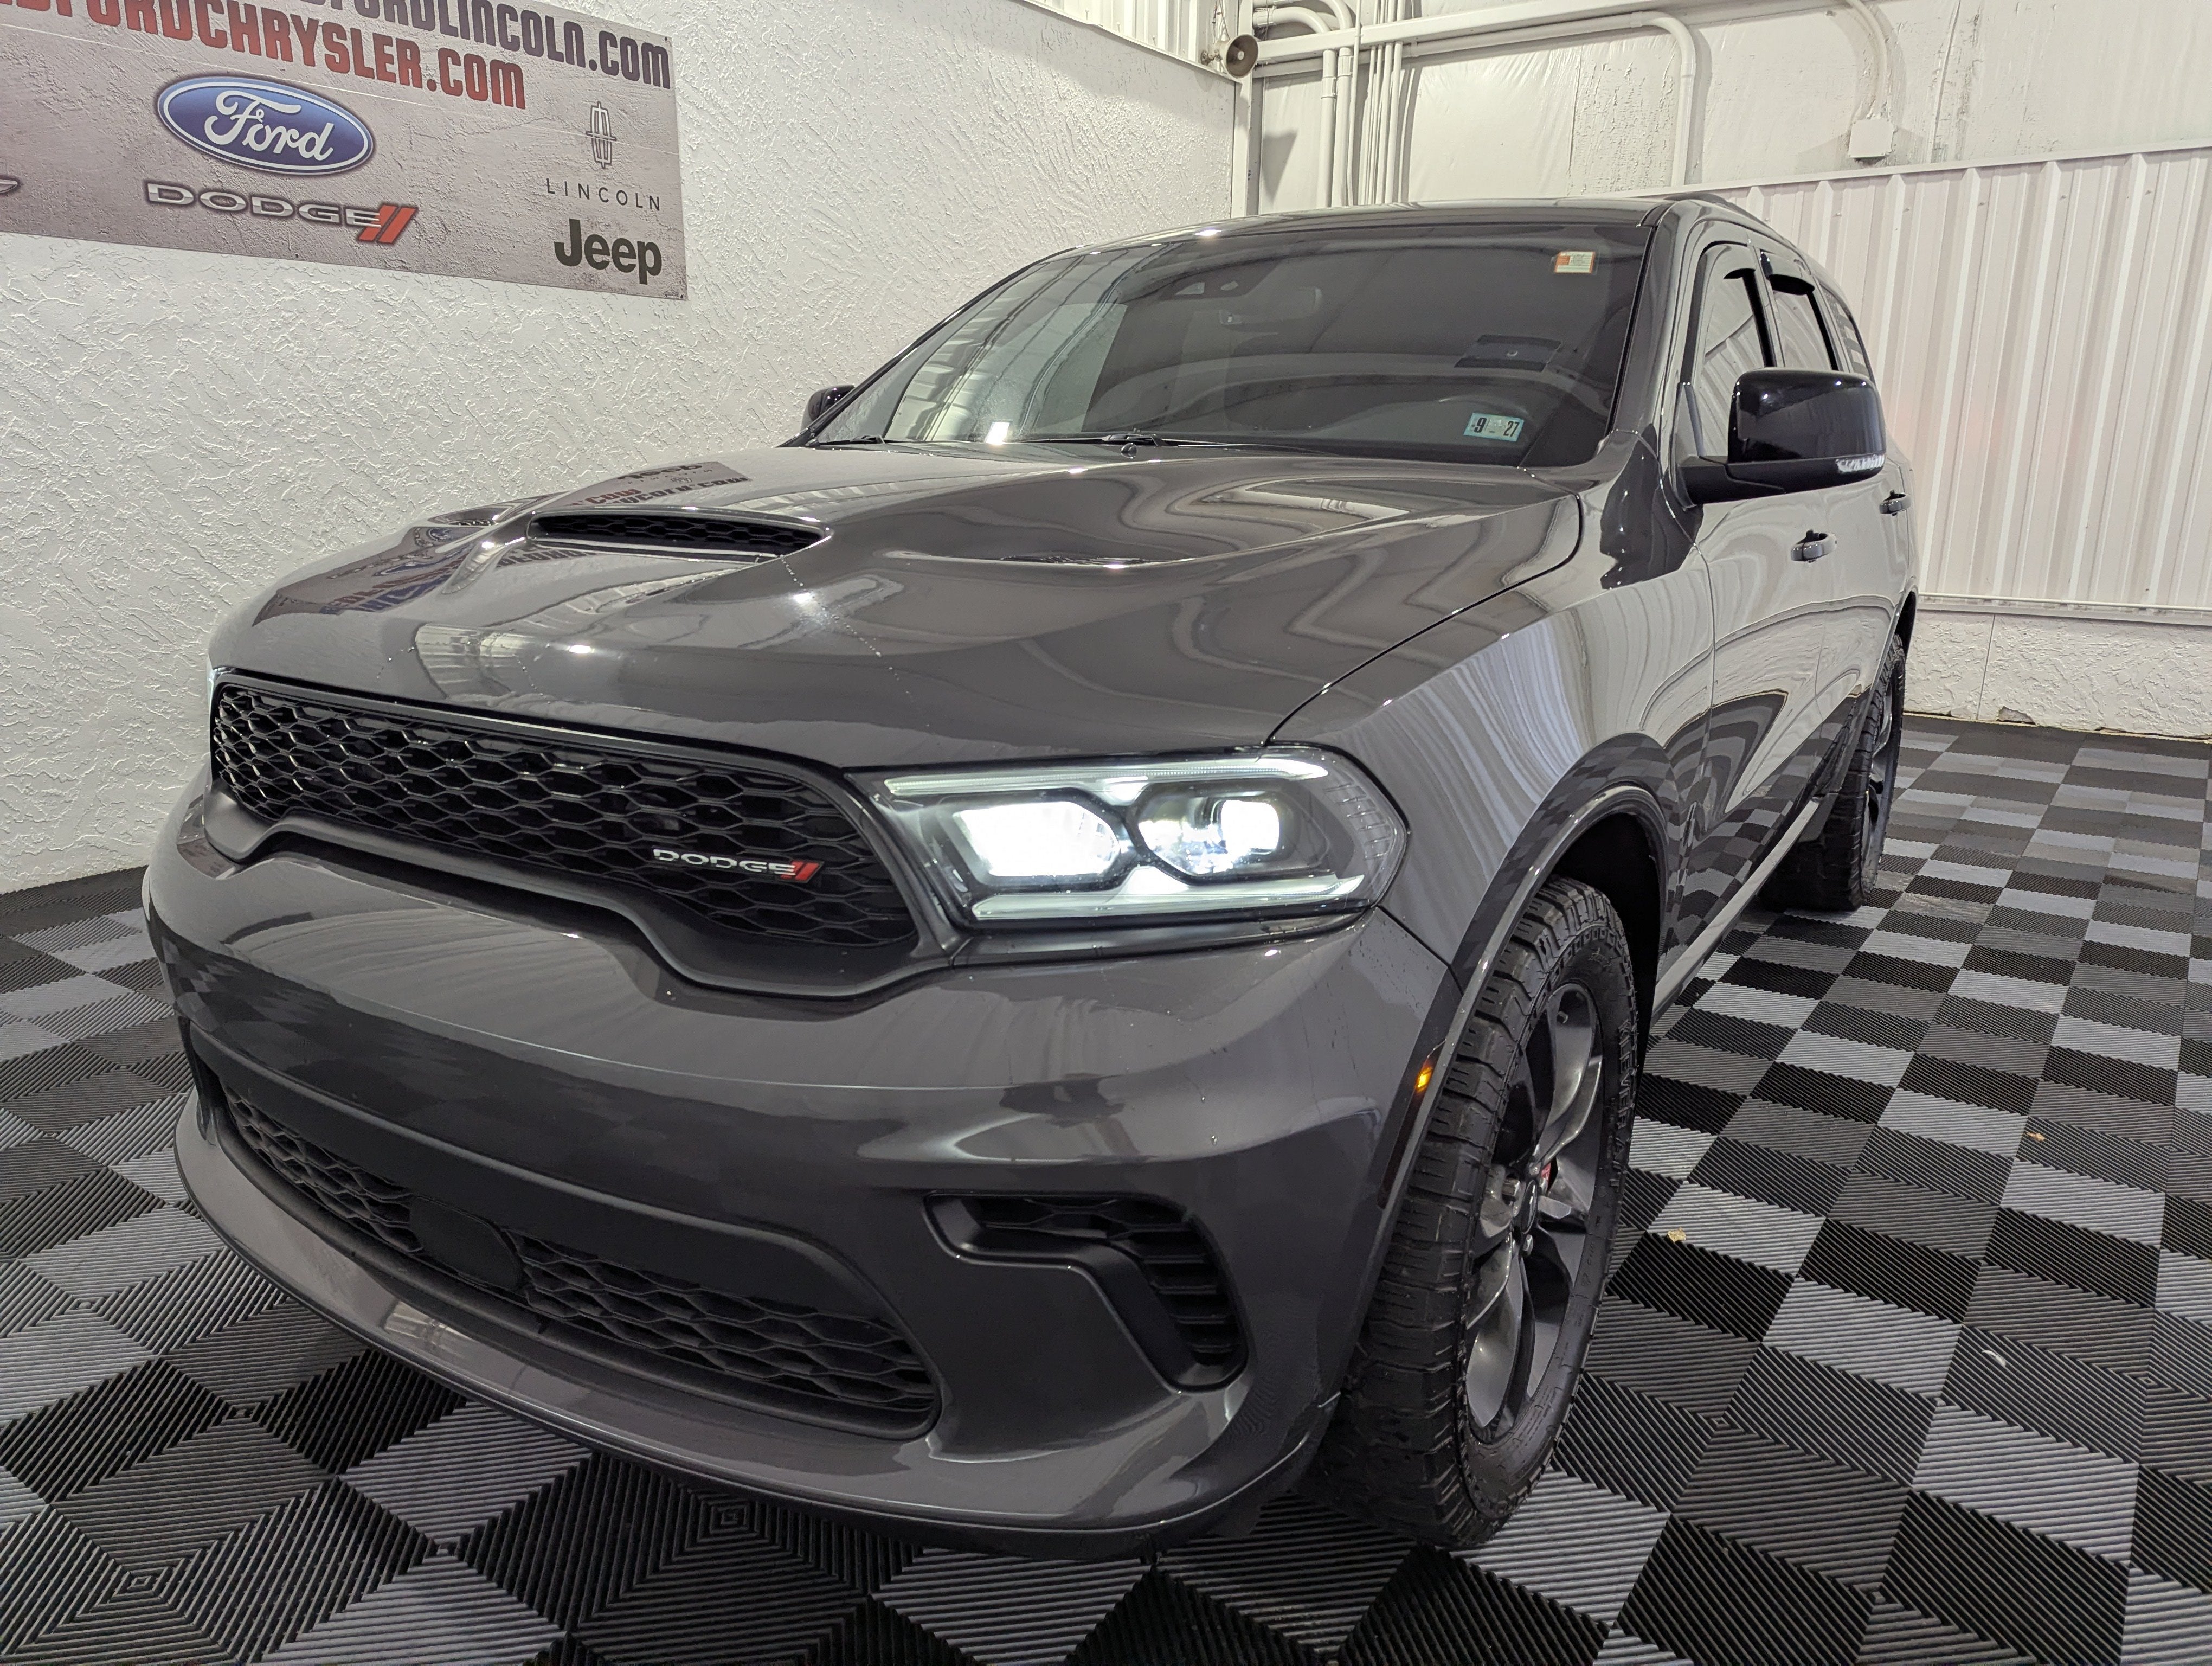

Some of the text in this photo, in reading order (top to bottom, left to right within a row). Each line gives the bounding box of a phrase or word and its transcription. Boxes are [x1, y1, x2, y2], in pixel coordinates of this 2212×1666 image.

[0, 0, 526, 109] RDCHRYSLER.COM
[300, 0, 671, 89] RDLINCOLN.COM
[204, 90, 334, 161] Ford
[147, 183, 382, 228] DODGE
[546, 178, 660, 211] LINCOLN
[554, 218, 662, 285] Jeep
[1474, 417, 1520, 438] 9 27
[653, 848, 796, 875] DODGE
